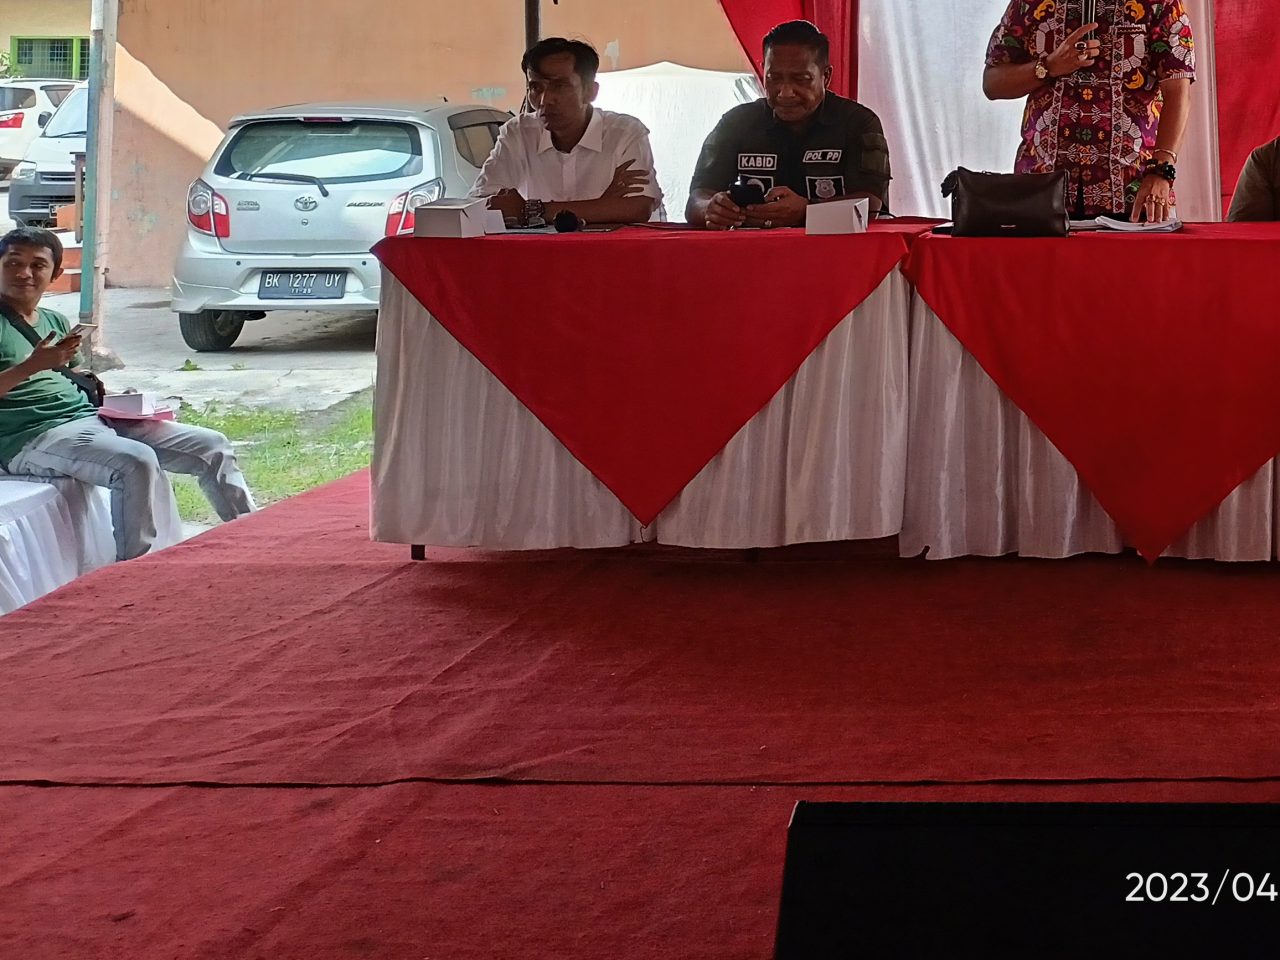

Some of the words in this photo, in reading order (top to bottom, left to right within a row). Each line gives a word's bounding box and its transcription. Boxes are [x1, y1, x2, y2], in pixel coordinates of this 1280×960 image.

[740, 156, 774, 169] KABID
[805, 151, 823, 161] POL
[826, 151, 839, 160] PP
[264, 273, 281, 288] BK
[288, 273, 317, 288] 1277
[325, 273, 342, 288] UY
